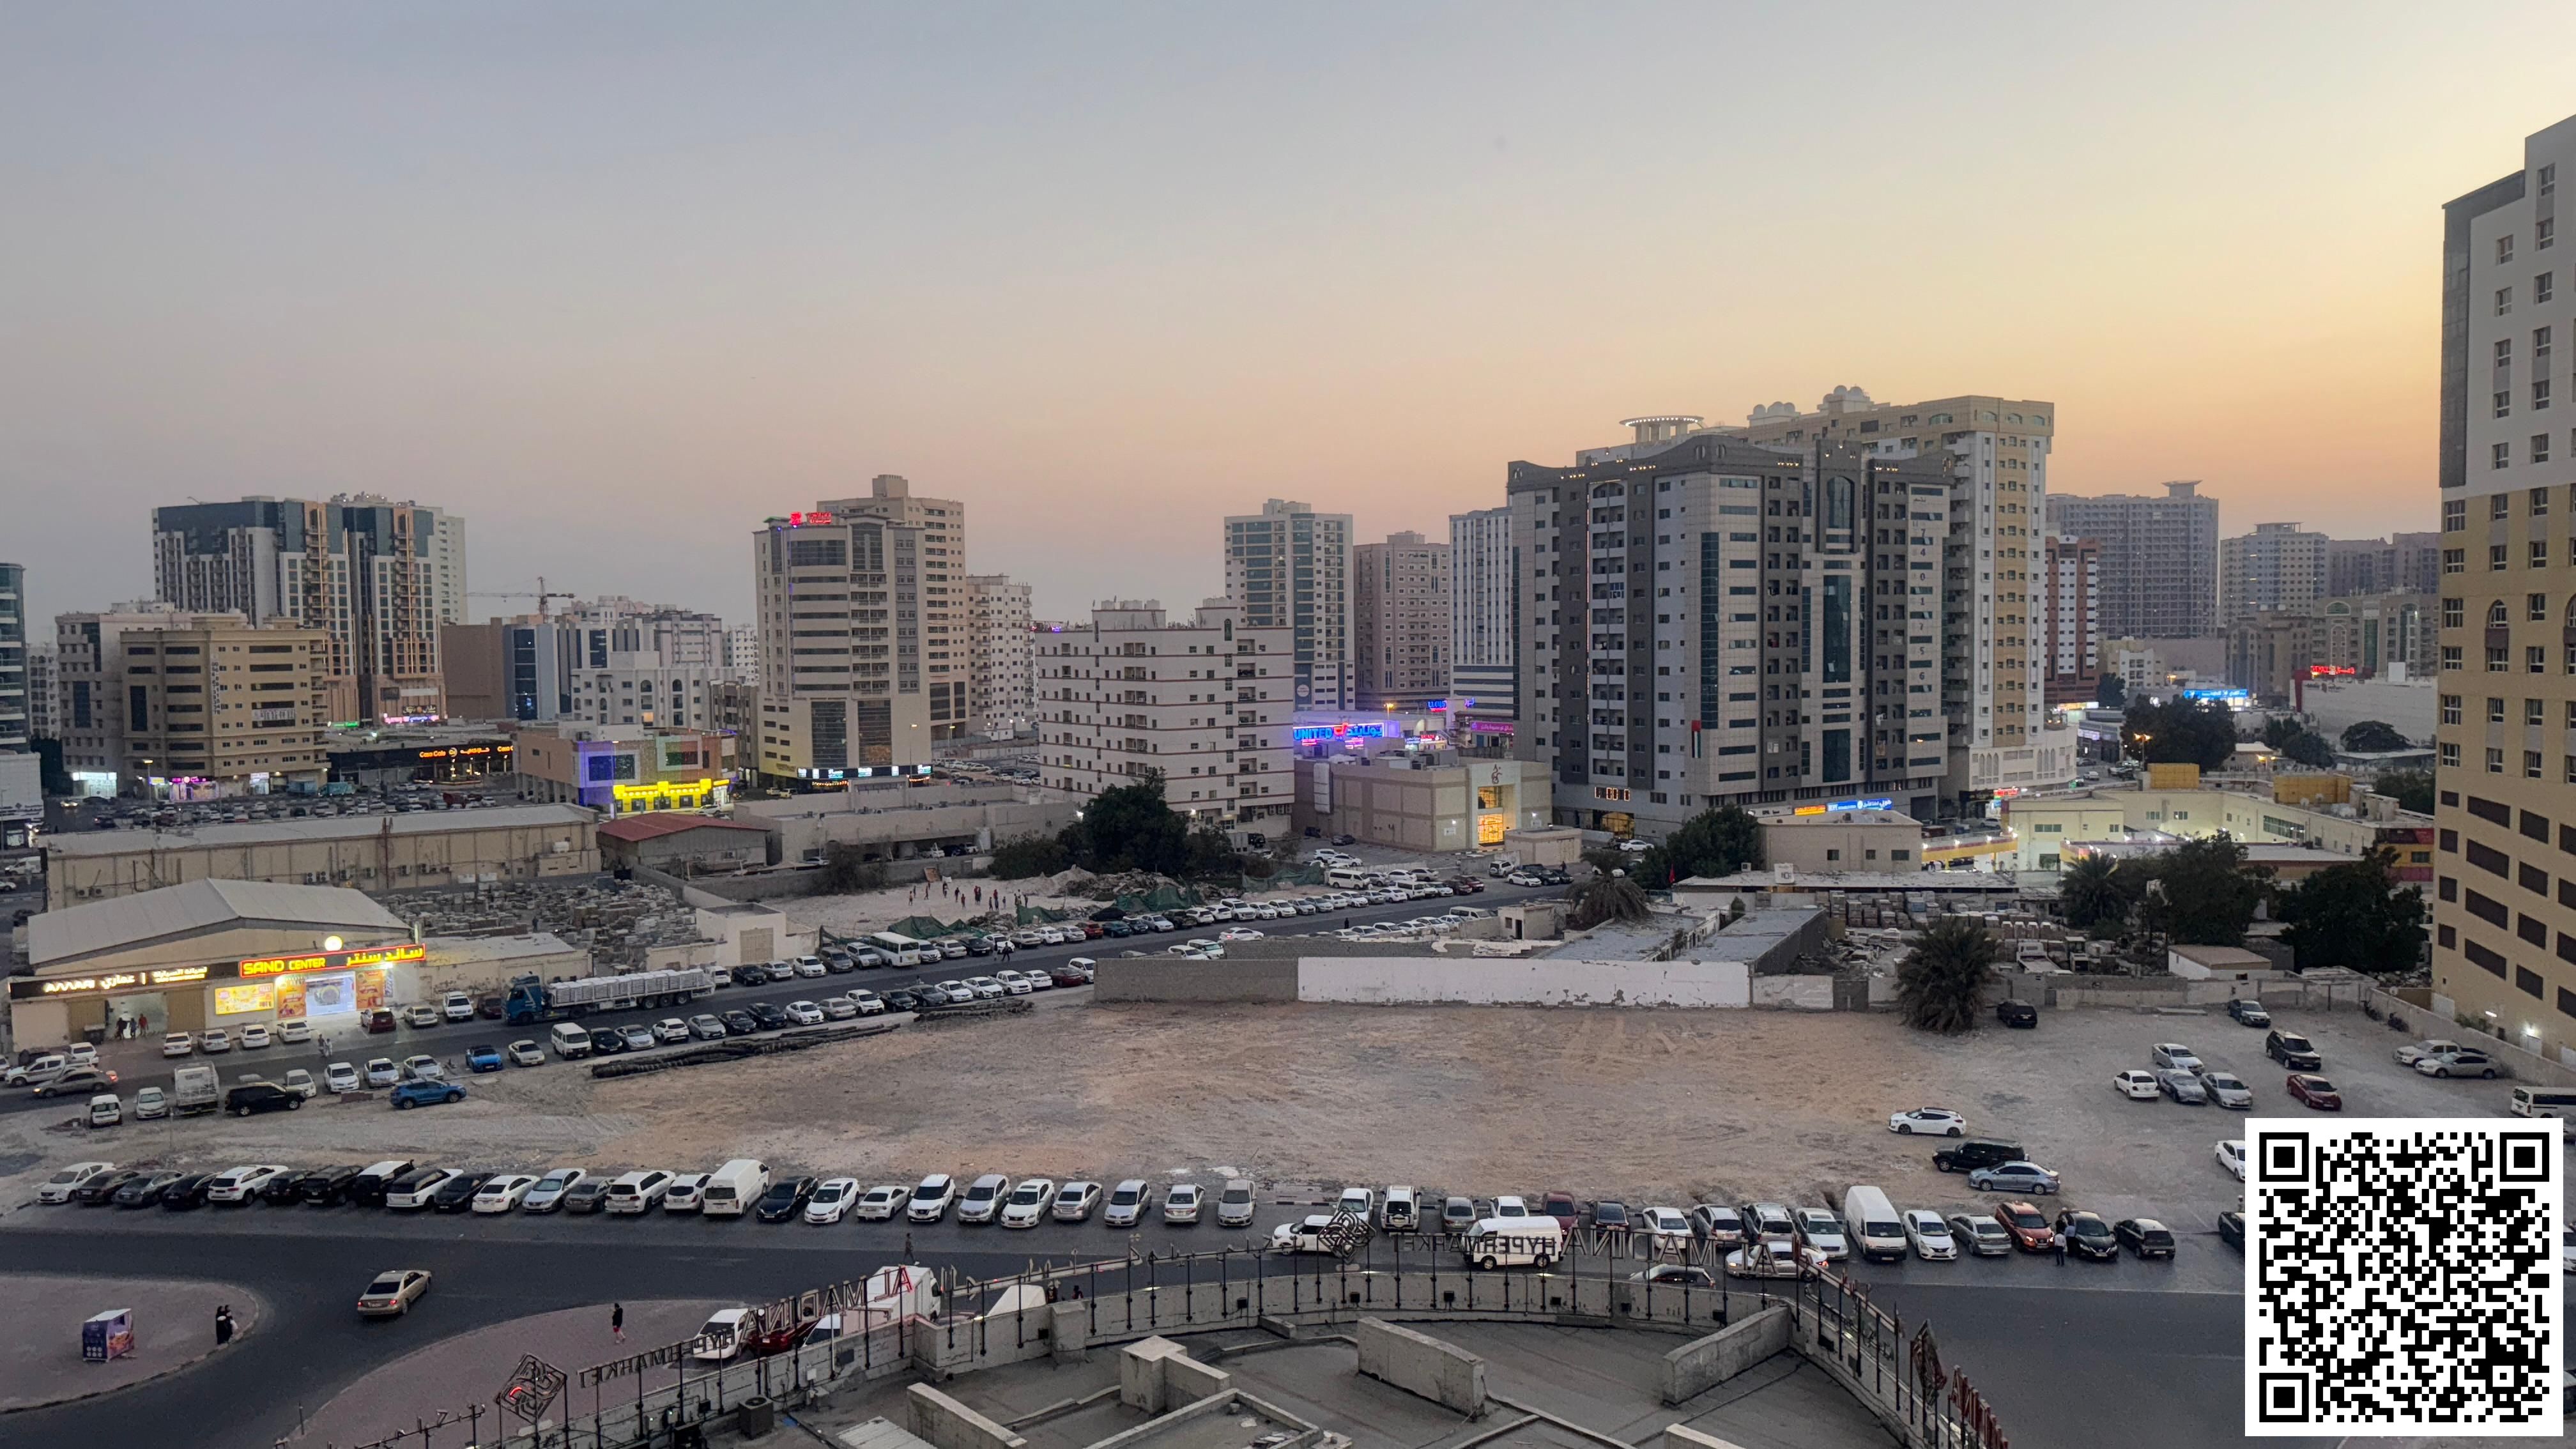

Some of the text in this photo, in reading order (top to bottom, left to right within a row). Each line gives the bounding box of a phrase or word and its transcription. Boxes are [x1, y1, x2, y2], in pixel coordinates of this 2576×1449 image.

[1293, 727, 1333, 740] UNITED
[1346, 724, 1383, 737] يونايتد
[346, 947, 423, 967] ساند سنتر
[243, 957, 326, 976] SAND CENTER
